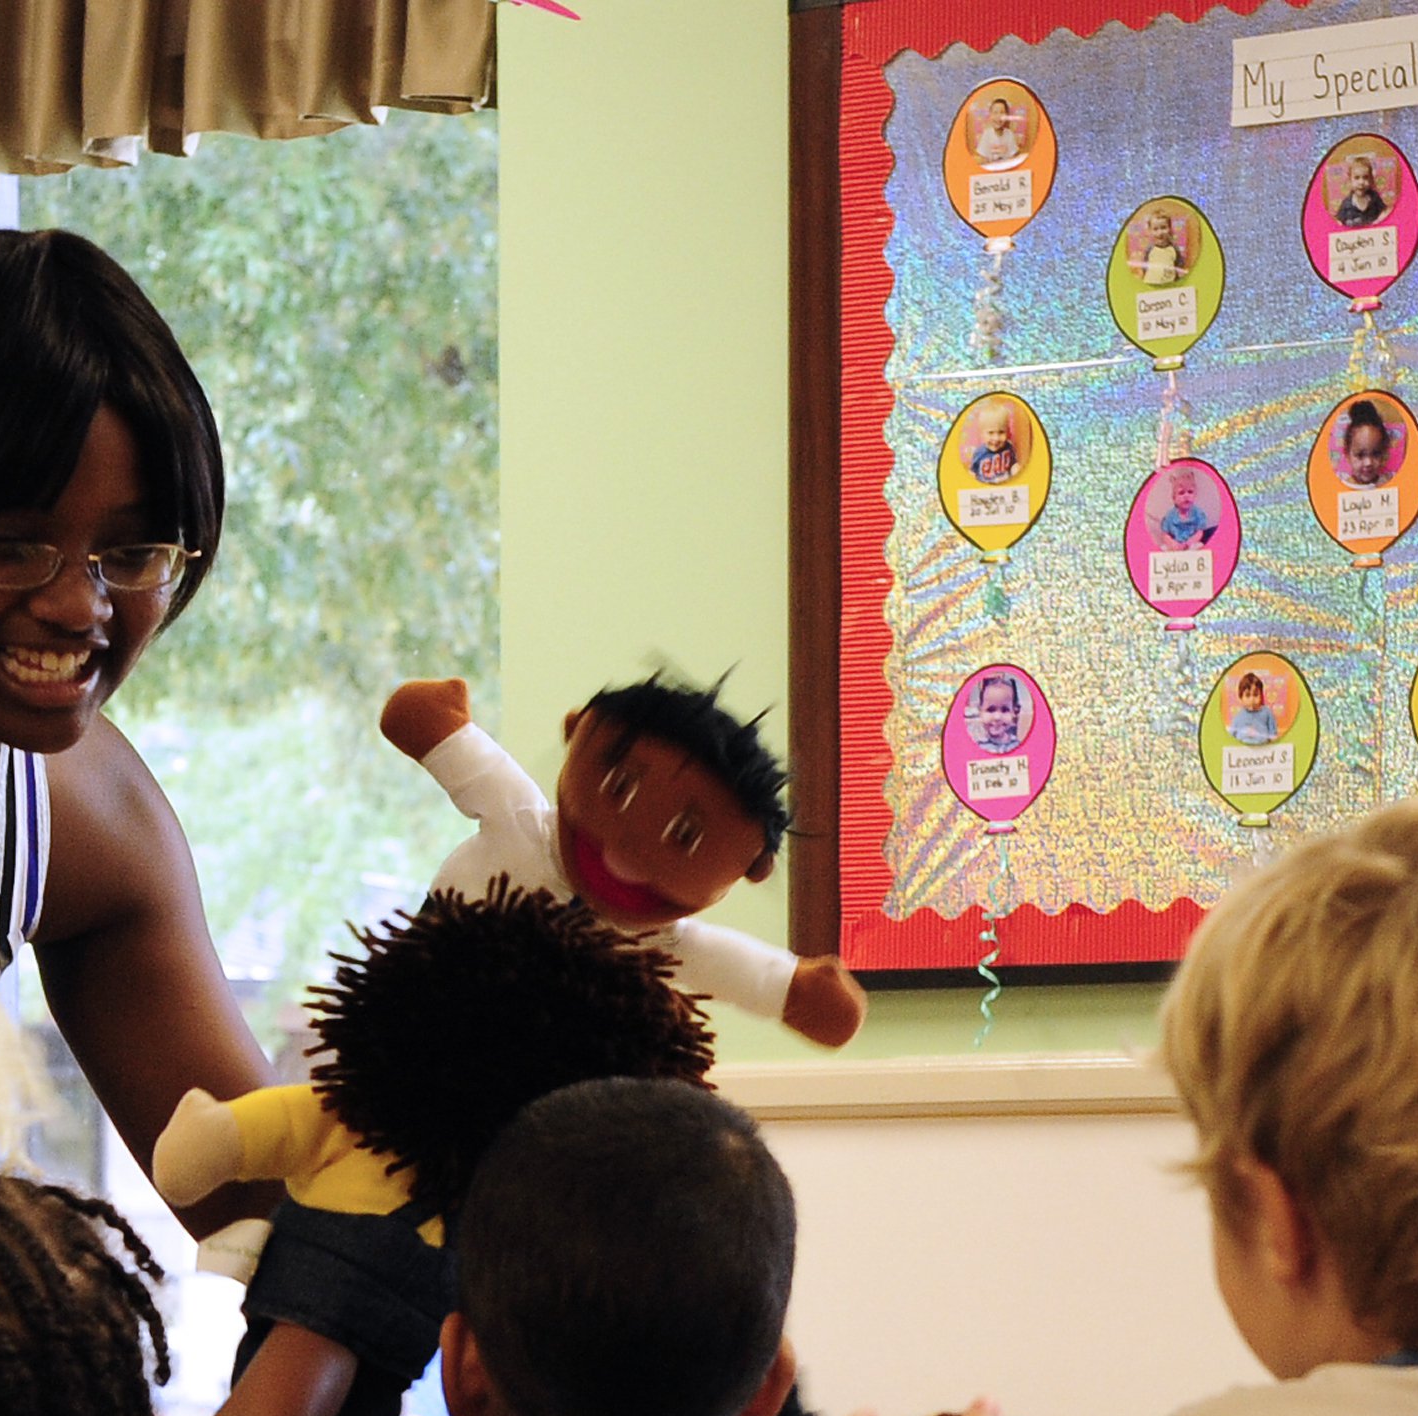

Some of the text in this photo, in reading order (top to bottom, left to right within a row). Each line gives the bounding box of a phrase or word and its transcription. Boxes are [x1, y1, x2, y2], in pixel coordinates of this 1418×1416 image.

[1242, 60, 1285, 119] My
[1313, 41, 1418, 111] Special
[1153, 556, 1190, 579] Lydia
